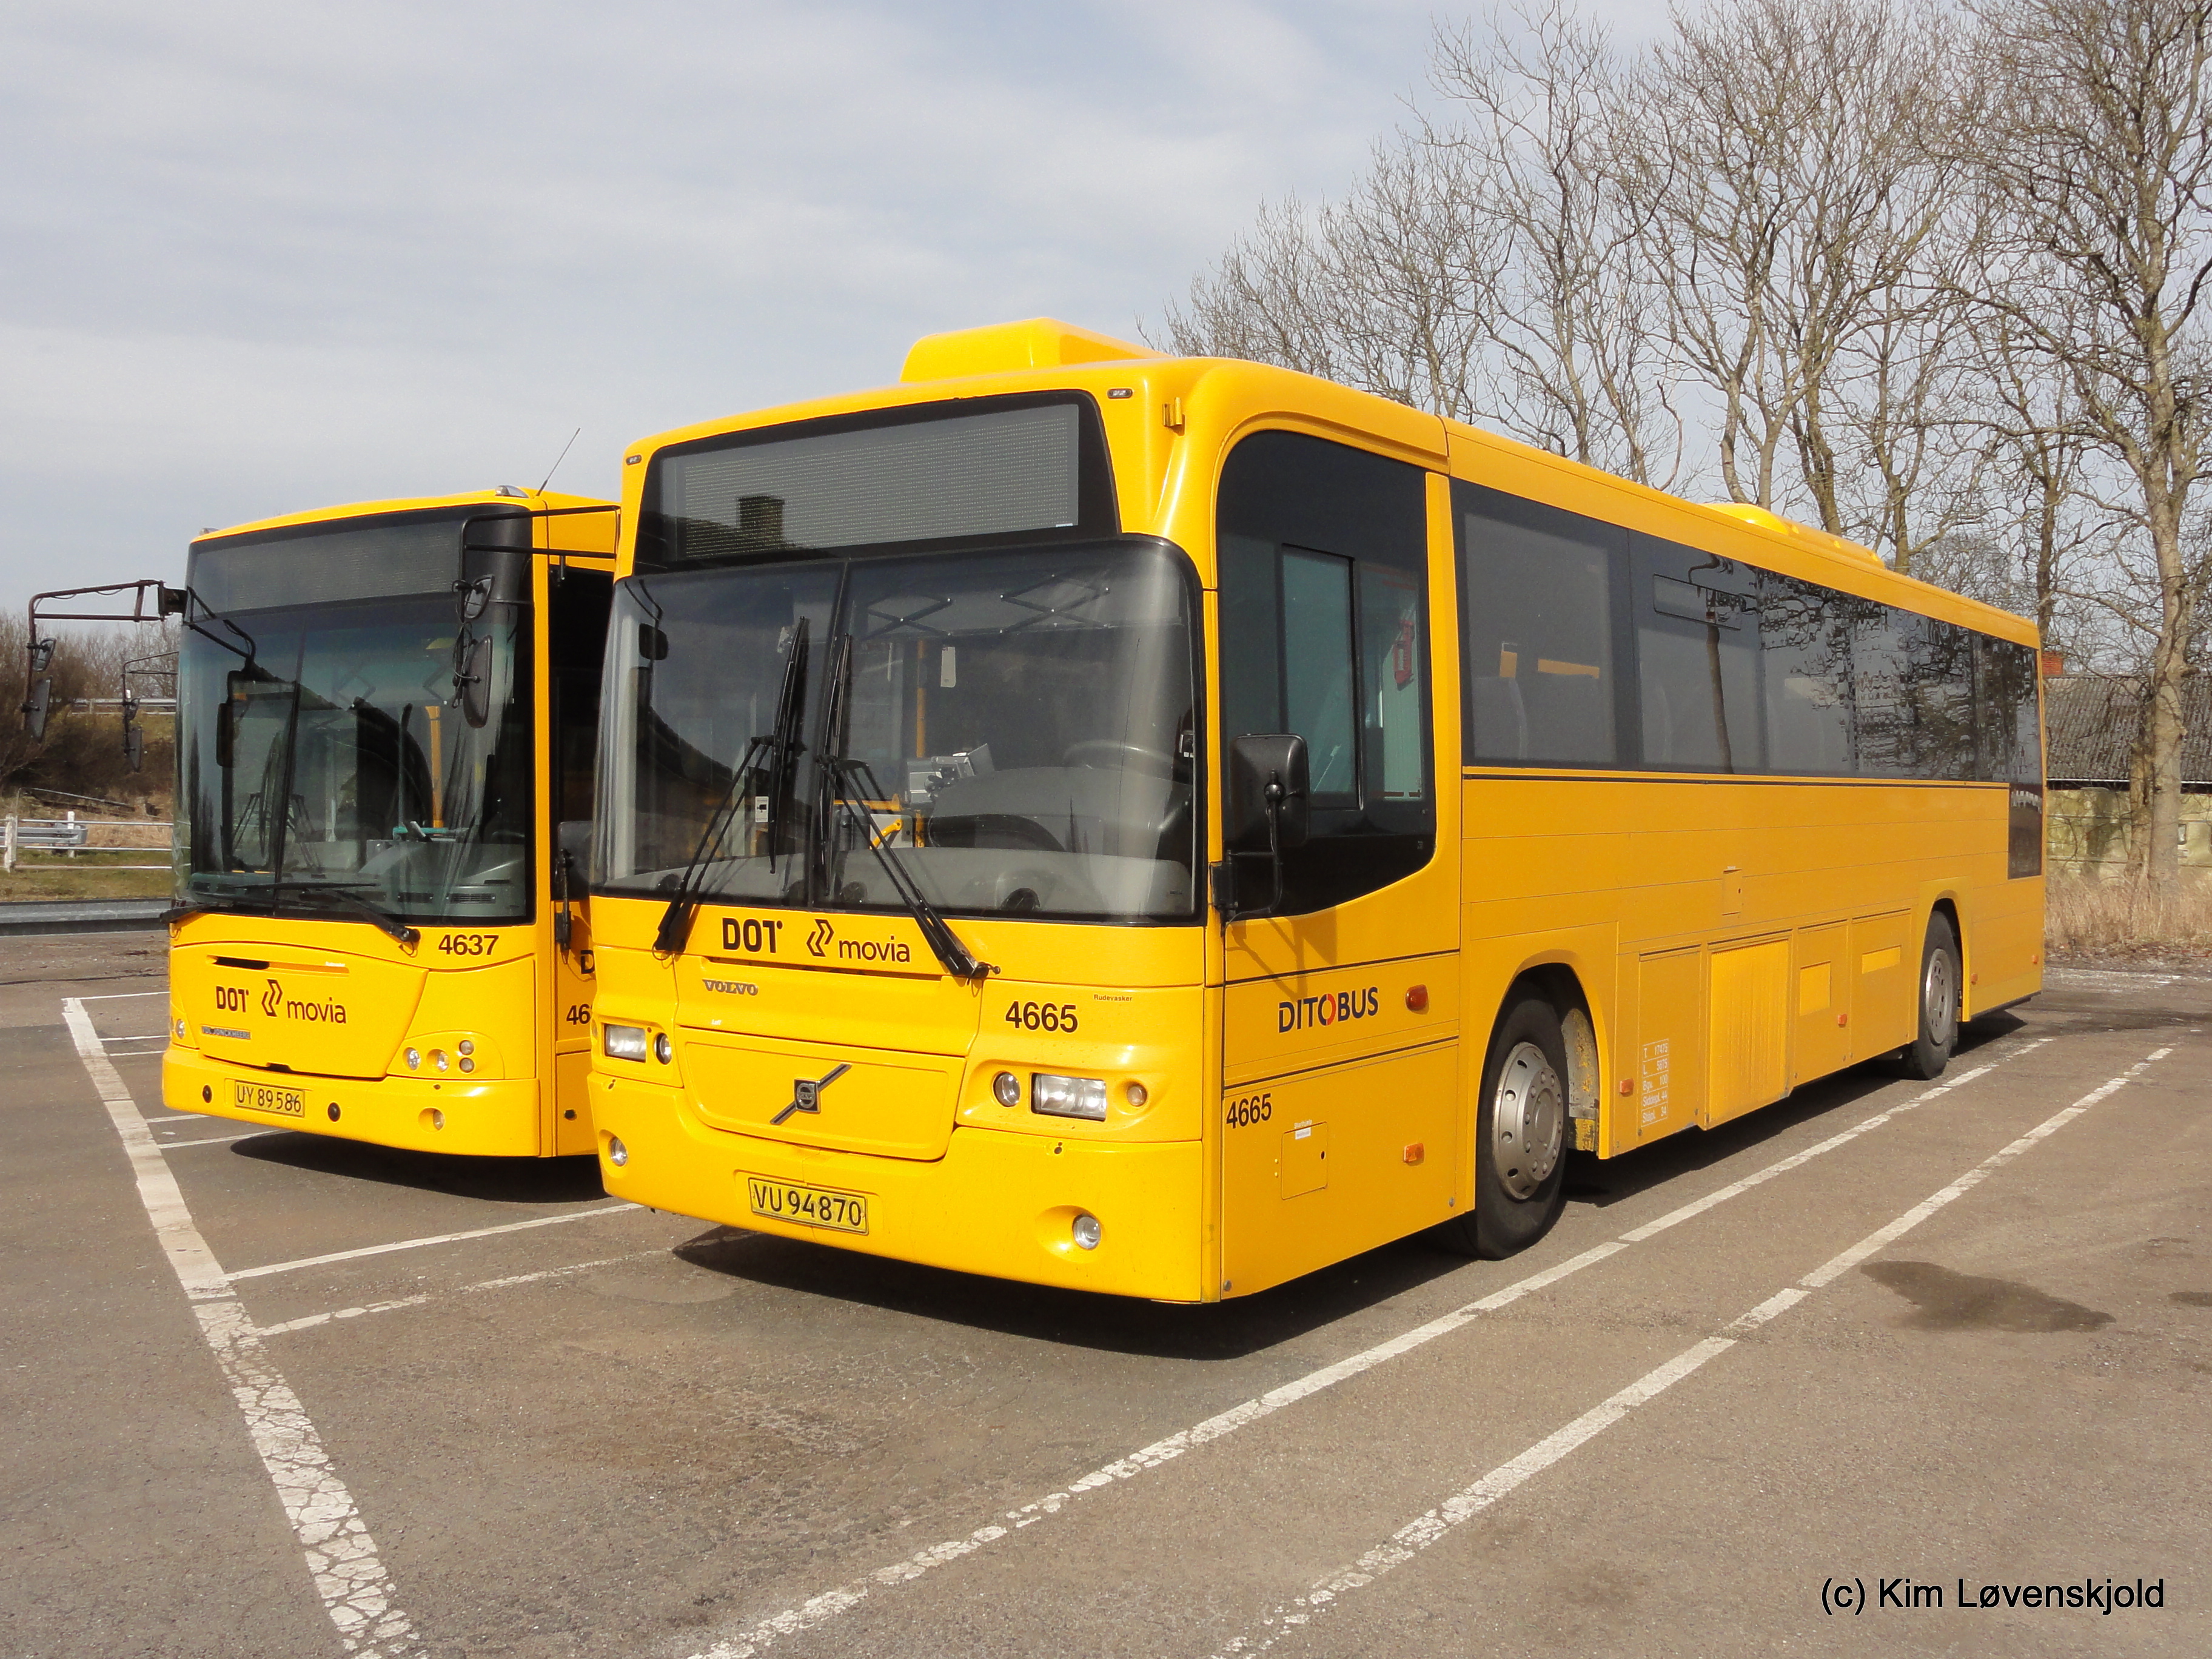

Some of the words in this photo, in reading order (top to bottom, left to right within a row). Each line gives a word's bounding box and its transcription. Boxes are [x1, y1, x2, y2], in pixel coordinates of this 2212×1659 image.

[438, 934, 499, 956] 4637
[722, 917, 783, 953] DOT
[839, 935, 910, 963] movia
[216, 986, 249, 1013] DOT
[287, 997, 347, 1024] movia
[702, 979, 759, 996] VOLVO
[1005, 1001, 1078, 1033] 4665
[1279, 986, 1379, 1033] DITOBUS
[237, 1085, 255, 1105] UY
[257, 1088, 301, 1113] 89586
[1225, 1093, 1272, 1129] 4665
[754, 1184, 782, 1212] VU
[788, 1190, 862, 1226] 94870
